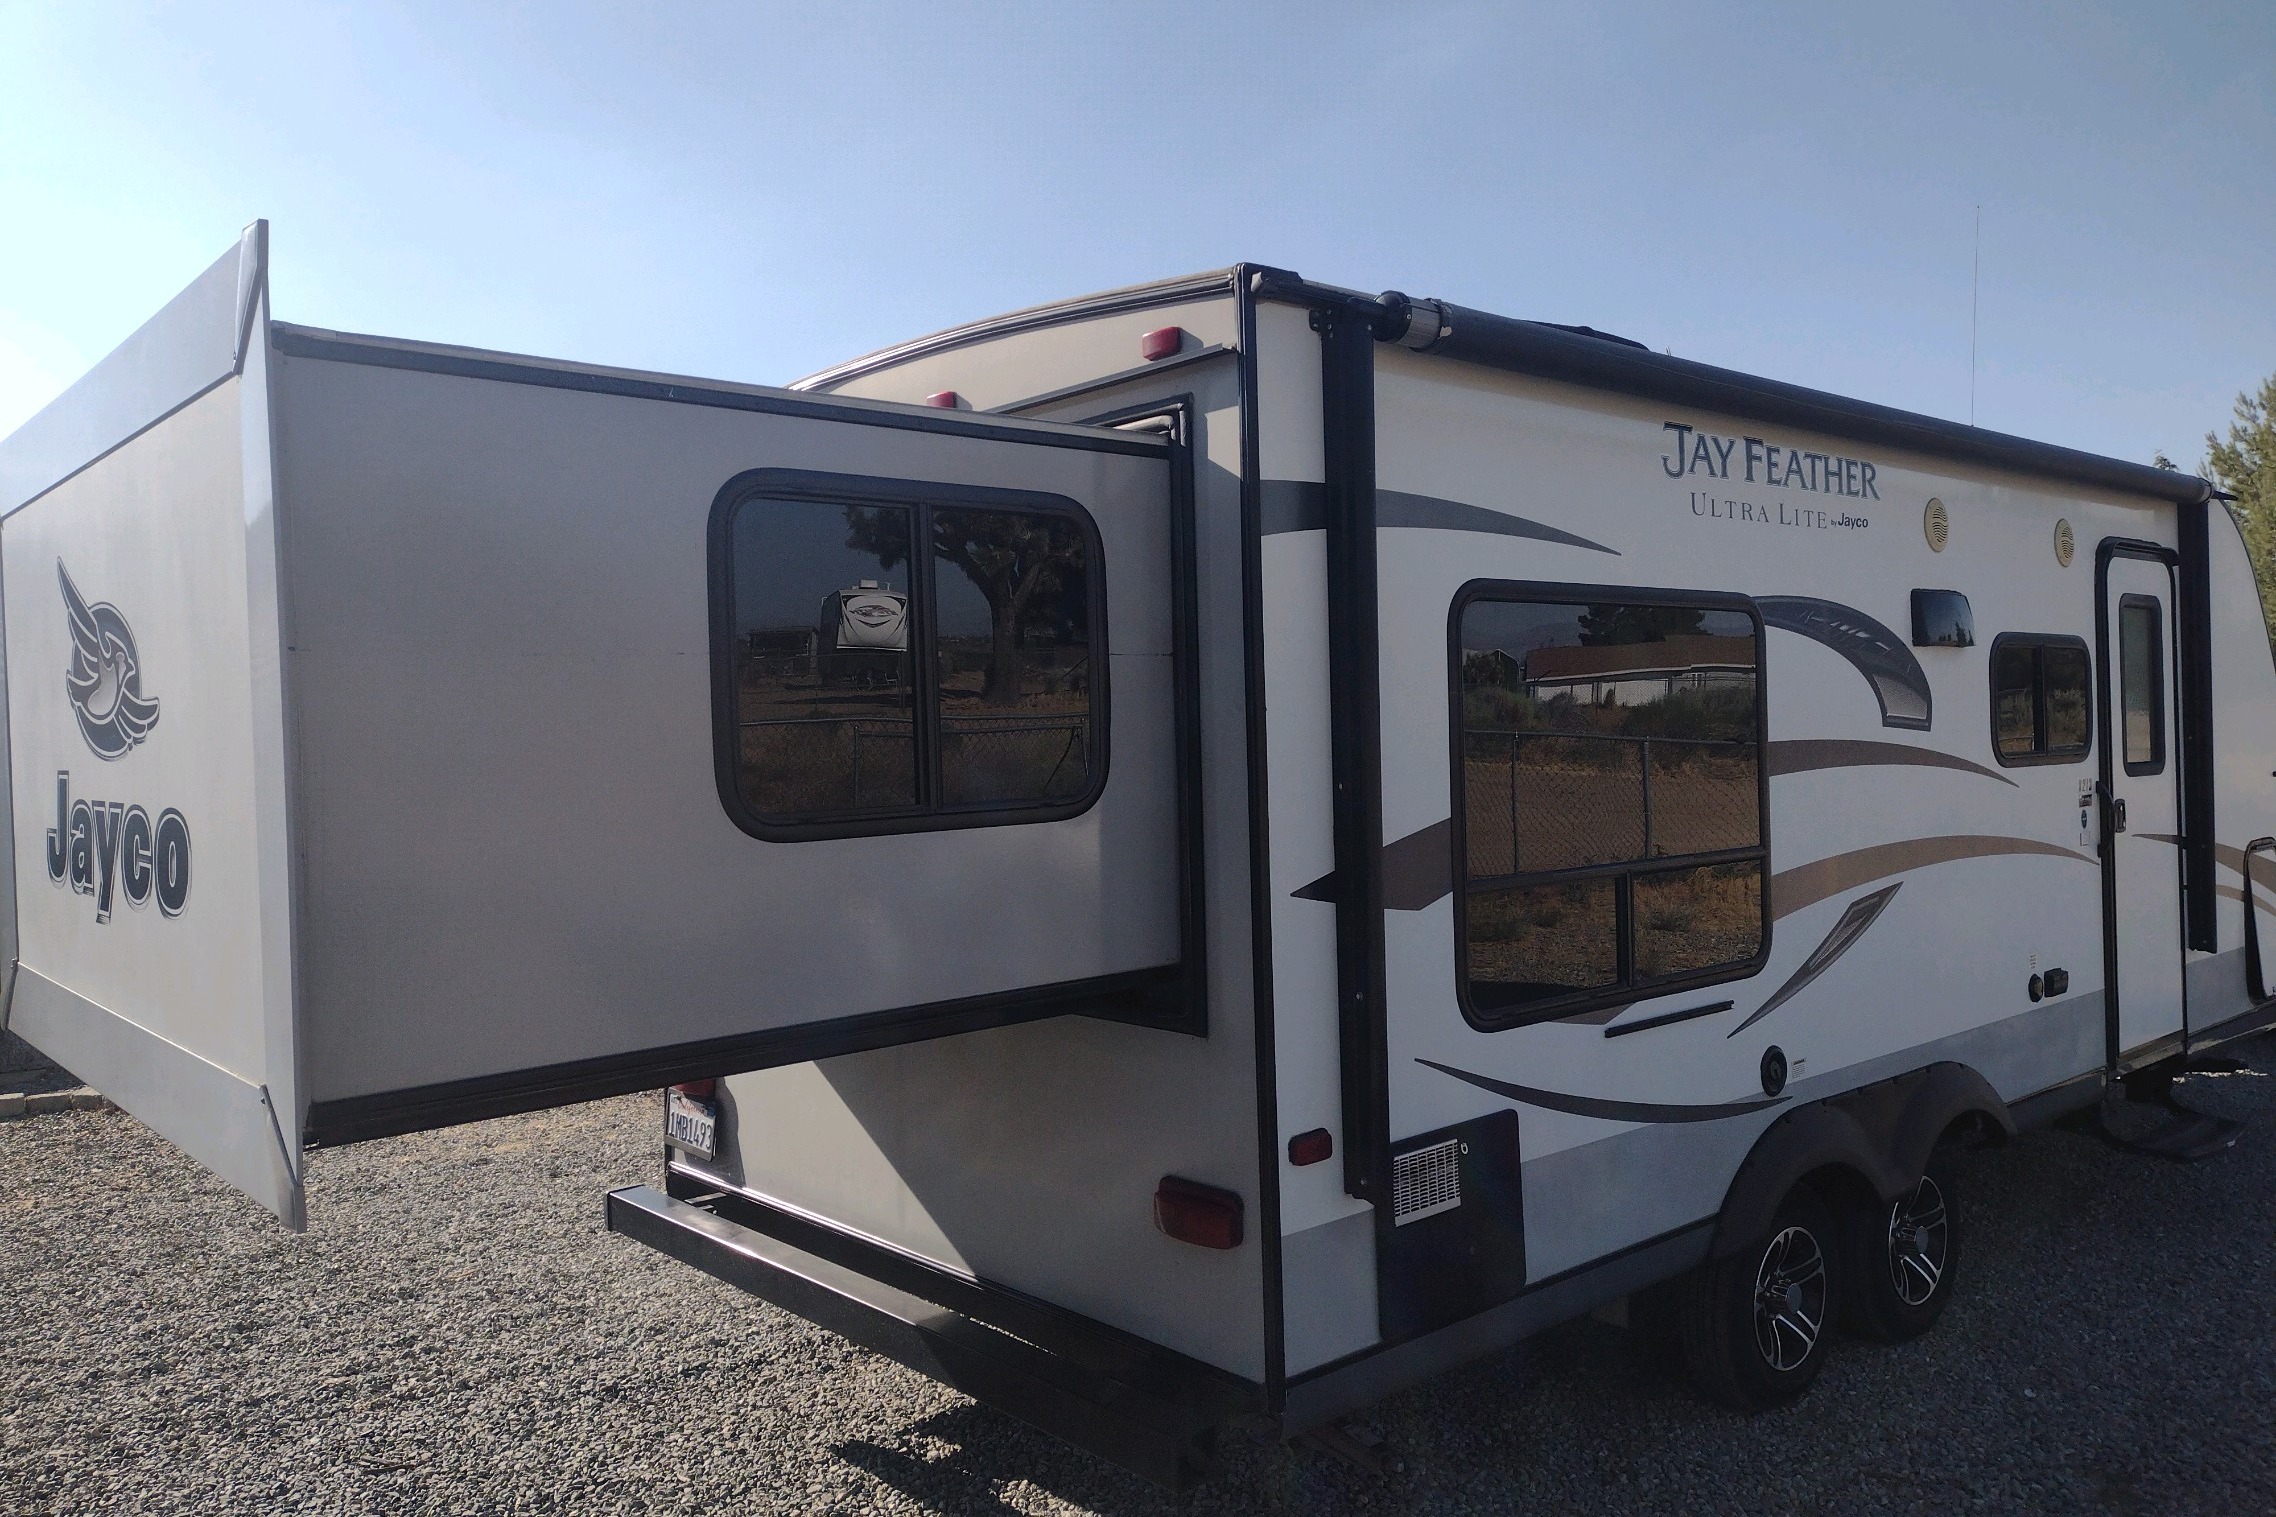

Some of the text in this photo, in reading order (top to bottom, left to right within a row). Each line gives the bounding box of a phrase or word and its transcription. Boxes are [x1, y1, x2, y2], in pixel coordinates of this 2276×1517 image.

[1661, 421, 1881, 502] JAY FEATHER
[1690, 492, 1869, 530] ULTRA LITE by Jayco
[46, 770, 192, 926] Jayco
